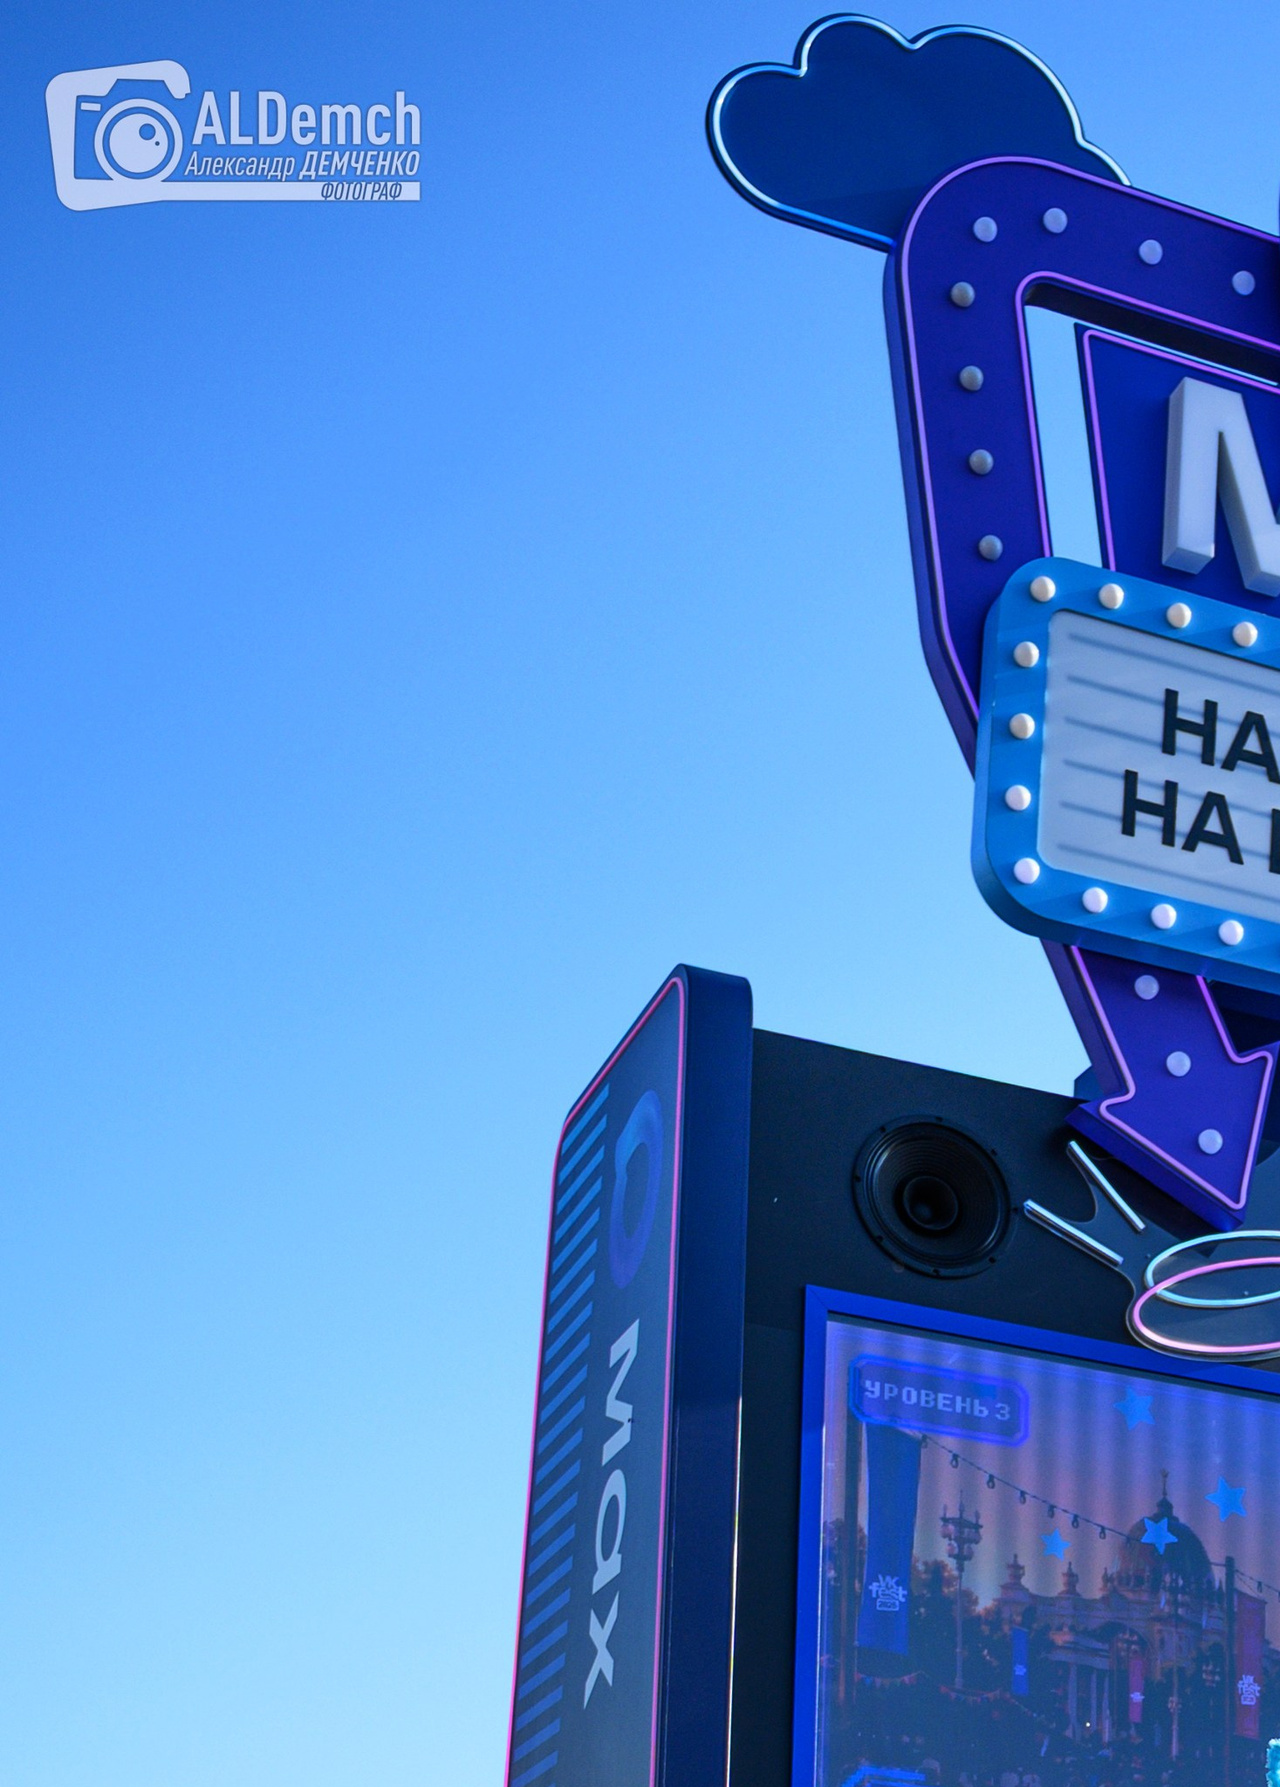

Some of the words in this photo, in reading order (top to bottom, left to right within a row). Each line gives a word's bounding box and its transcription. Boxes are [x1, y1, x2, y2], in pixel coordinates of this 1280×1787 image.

[1120, 769, 1244, 866] НА
[864, 1379, 989, 1418] УРОВЕНЬ
[994, 1403, 1011, 1421] 3
